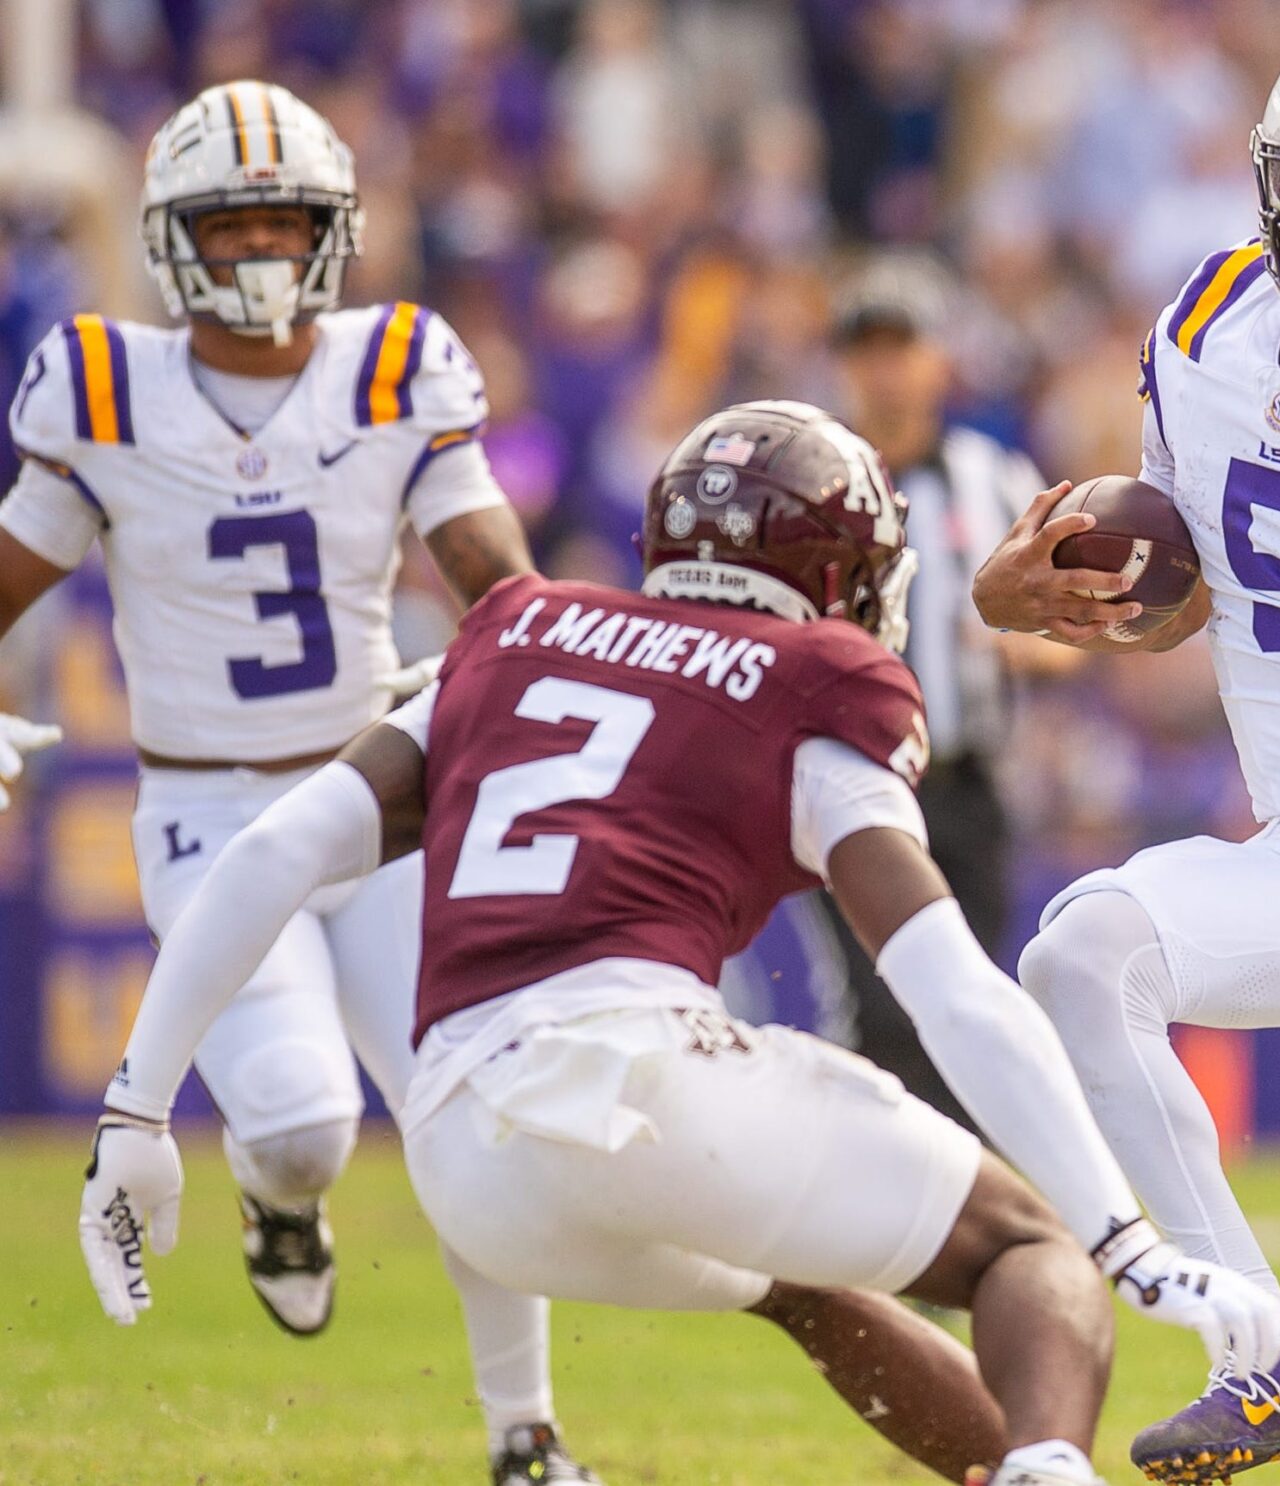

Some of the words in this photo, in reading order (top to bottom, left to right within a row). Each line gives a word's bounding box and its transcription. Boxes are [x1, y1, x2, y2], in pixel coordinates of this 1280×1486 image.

[208, 510, 337, 700] 3
[499, 597, 547, 648] J.
[541, 600, 776, 702] MATHEWS
[447, 676, 656, 899] 2
